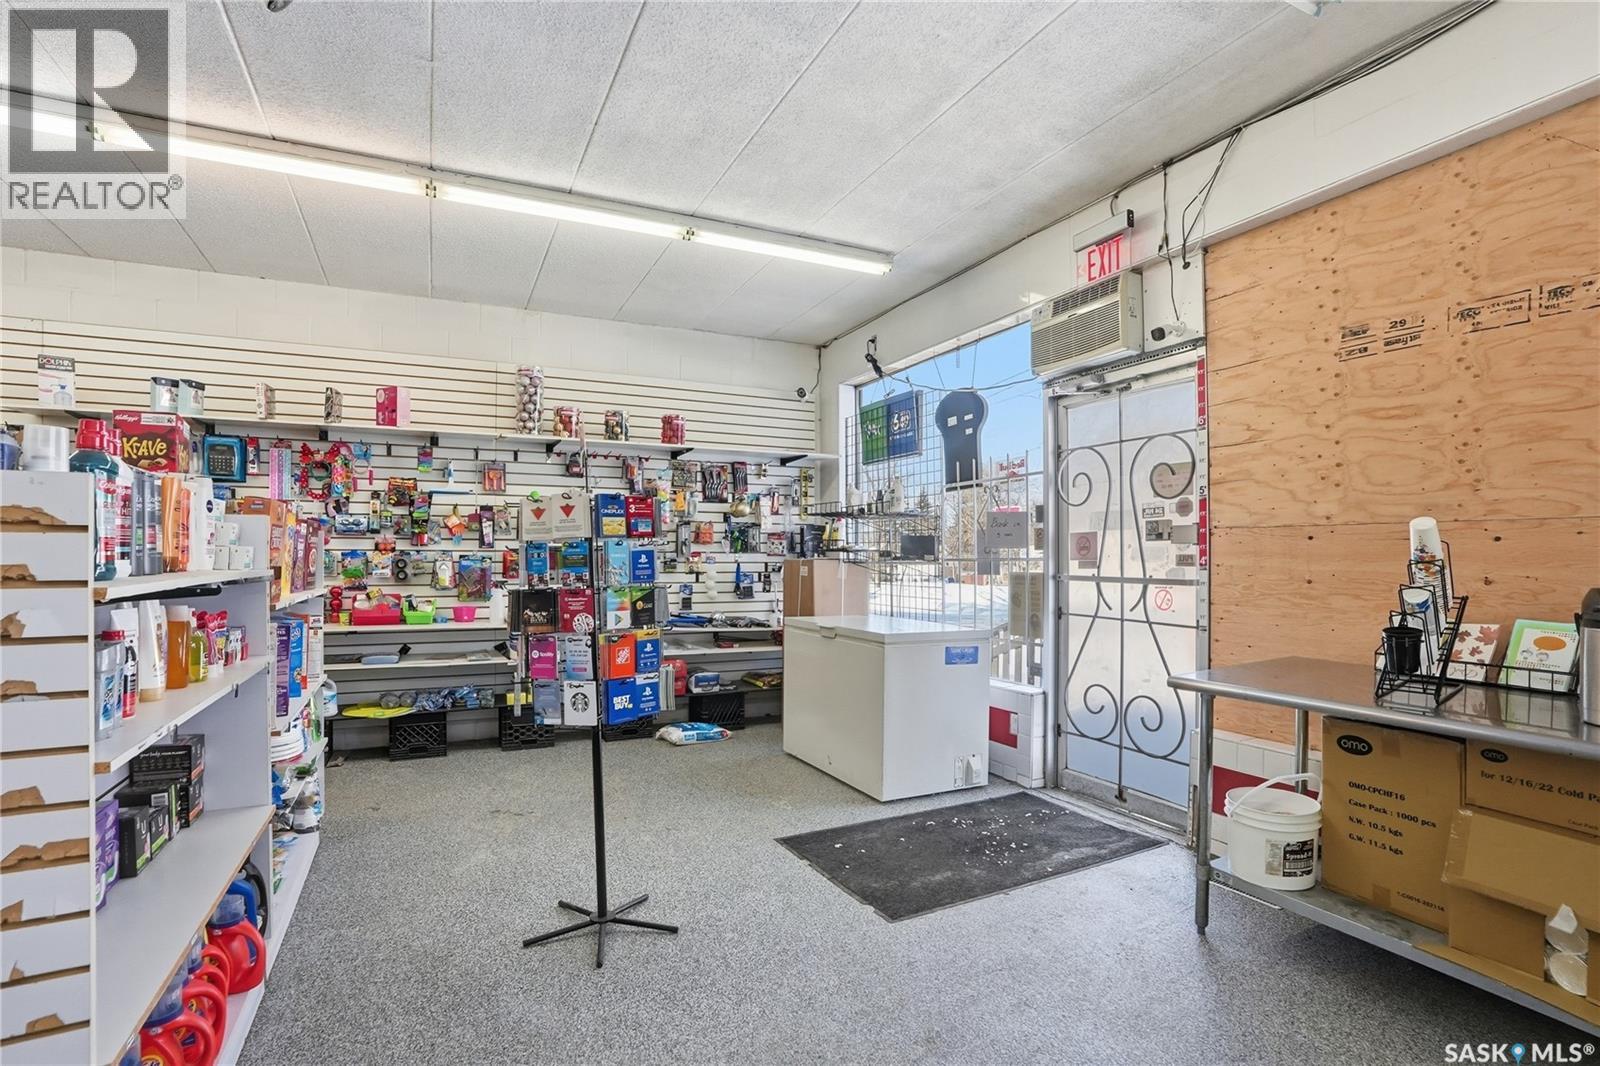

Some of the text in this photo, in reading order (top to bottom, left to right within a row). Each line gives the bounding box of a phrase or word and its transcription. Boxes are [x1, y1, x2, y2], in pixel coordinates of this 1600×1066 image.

[1087, 235, 1124, 282] EXIT
[39, 357, 72, 366] DOLPHIN
[628, 504, 636, 513] 3
[613, 695, 631, 705] BEST
[614, 702, 628, 711] BUY
[1341, 738, 1369, 752] omo
[1483, 751, 1505, 761] omo
[1348, 780, 1406, 801] OMO-CPCHF16
[1480, 770, 1496, 780] for
[1500, 774, 1553, 793] 12/16/22
[1557, 786, 1584, 799] Cold
[1348, 798, 1367, 809] Case
[1368, 804, 1388, 815] Pack
[1396, 811, 1419, 823] 1000
[1421, 819, 1437, 828] pcs
[1348, 815, 1404, 837] N.W. 10.5 kgs
[1348, 833, 1404, 856] G.W. 11.5 kgs
